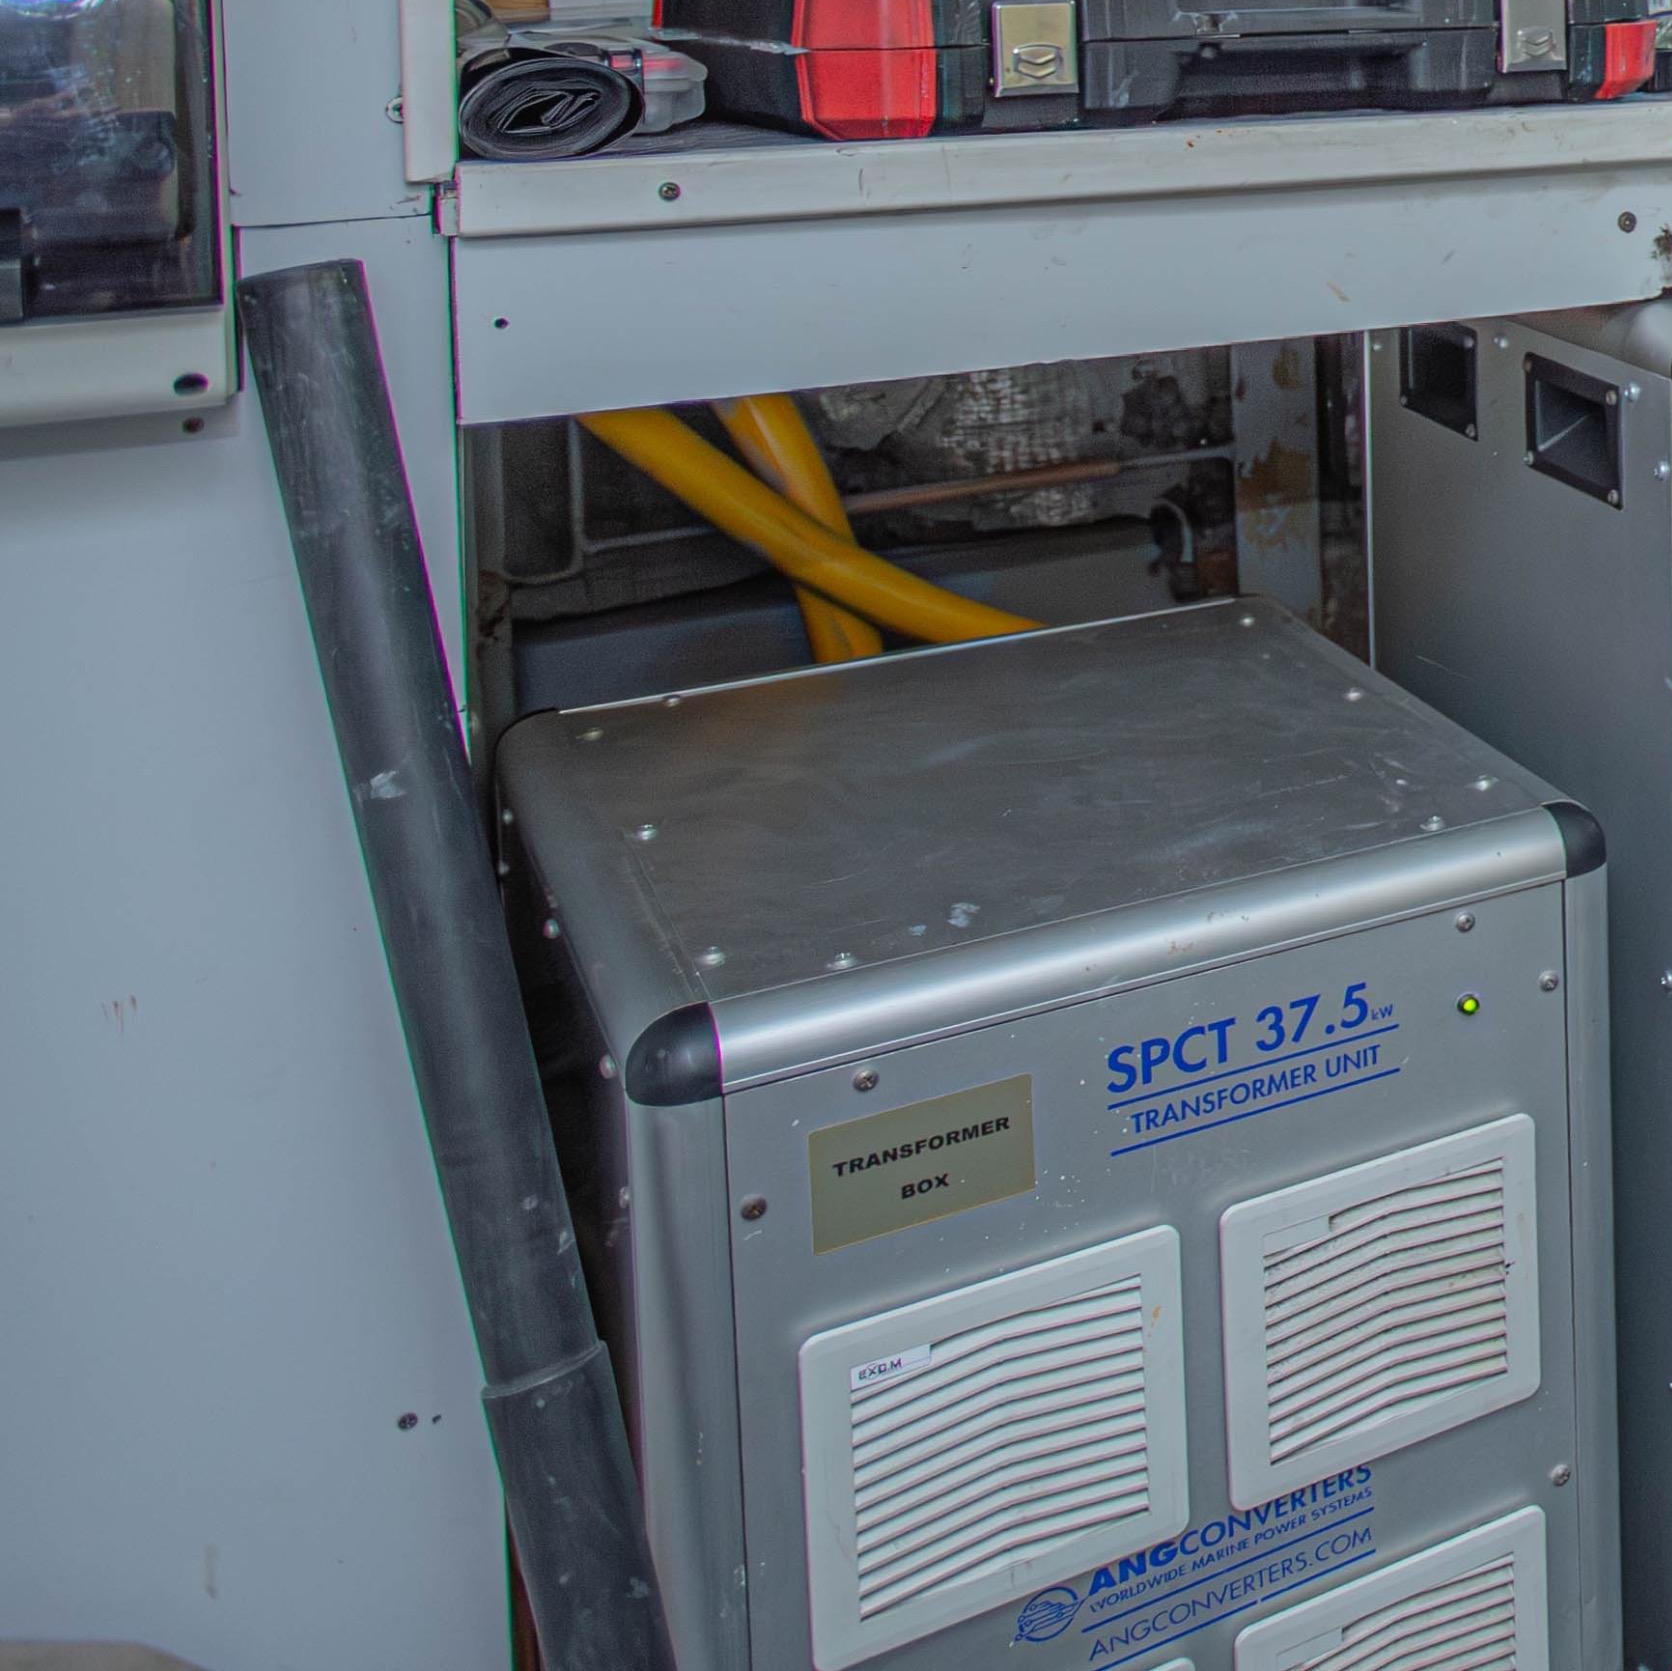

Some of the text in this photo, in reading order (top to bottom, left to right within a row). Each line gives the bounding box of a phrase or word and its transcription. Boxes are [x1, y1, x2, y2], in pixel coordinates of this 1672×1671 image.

[1107, 1017, 1236, 1094] SPCT
[1255, 982, 1369, 1052] 37.5
[1130, 1044, 1381, 1134] TRANSFORMER UNIT
[832, 1116, 1011, 1177] TRANSFORMER
[901, 1173, 949, 1200] BOX
[1088, 1464, 1372, 1597] ANGCONVERTERS
[1089, 1486, 1373, 1614] WORLDWIDE MARINE POWER SYSTEMS
[1089, 1527, 1372, 1663] ANGCONVERTERS.COM
